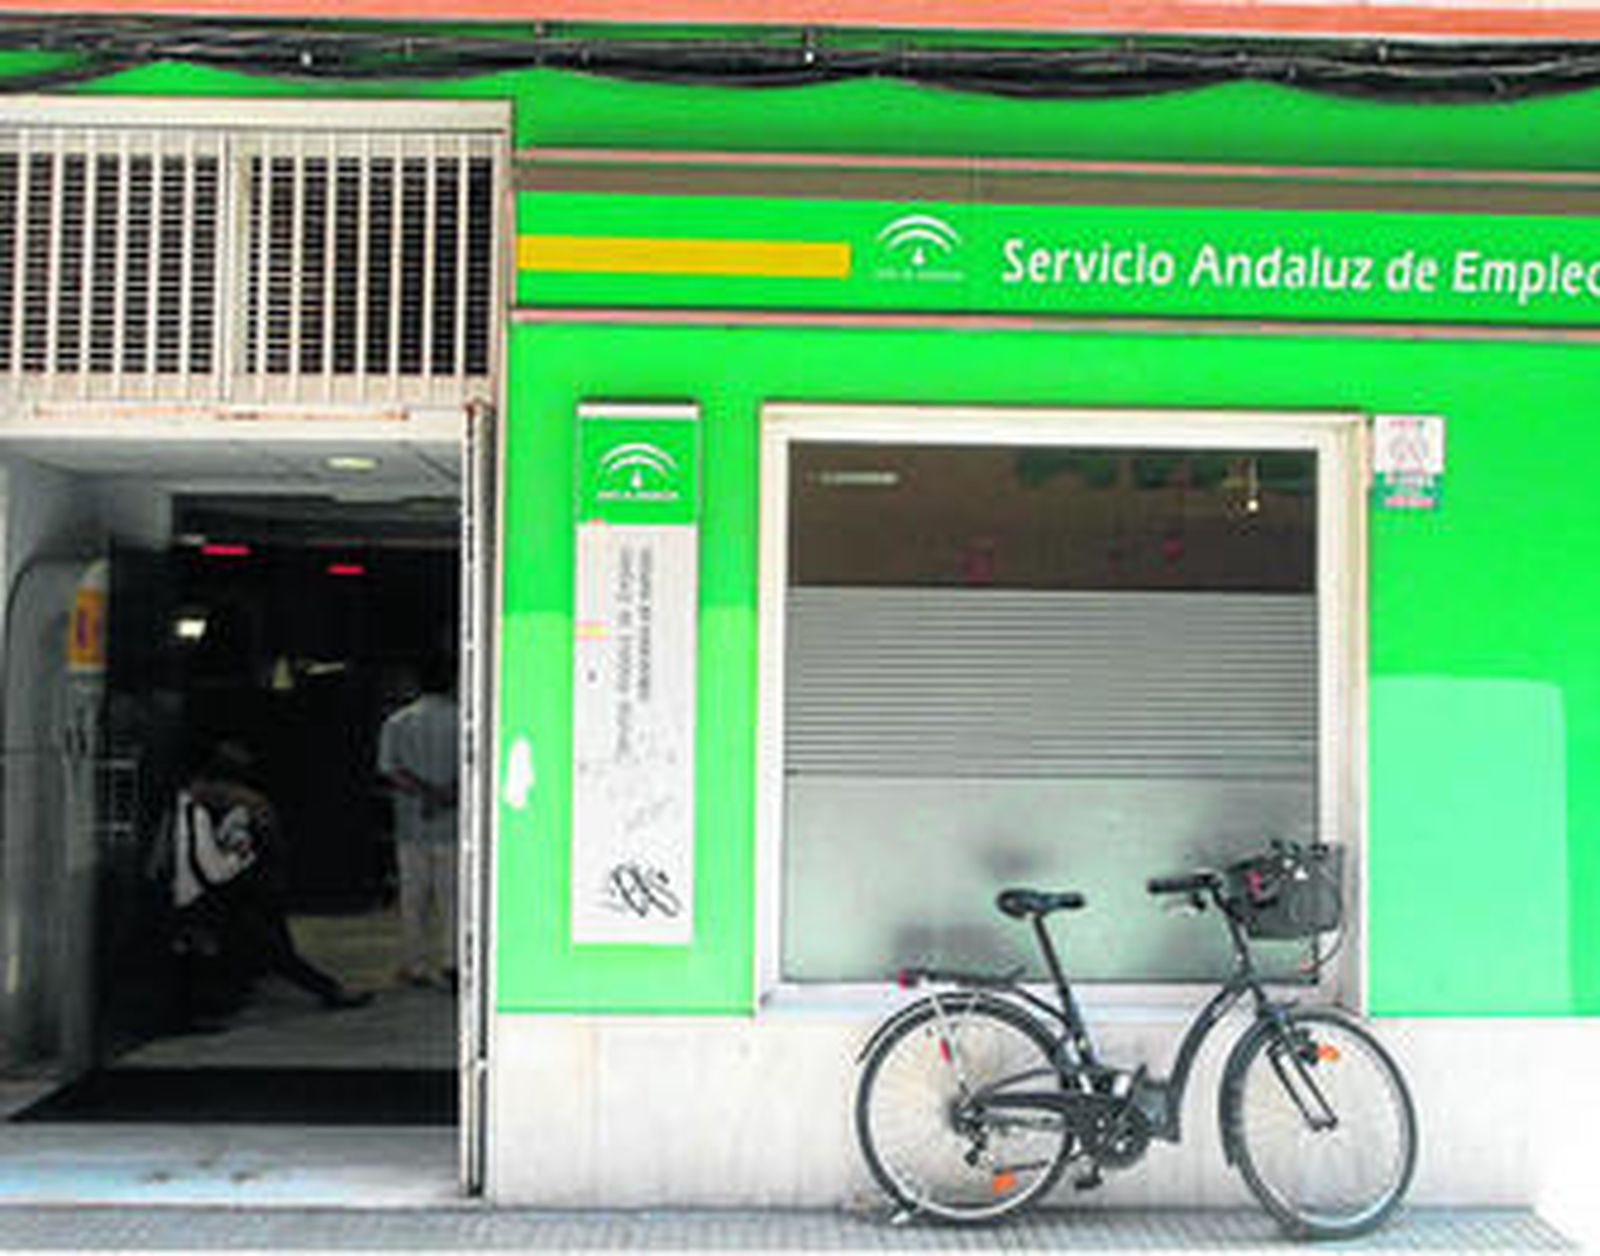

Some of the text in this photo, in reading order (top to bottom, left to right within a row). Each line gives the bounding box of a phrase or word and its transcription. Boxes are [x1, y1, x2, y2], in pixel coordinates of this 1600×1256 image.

[1002, 238, 1175, 285] Servicio
[1188, 243, 1374, 290] Andaluz
[1385, 249, 1439, 292] de
